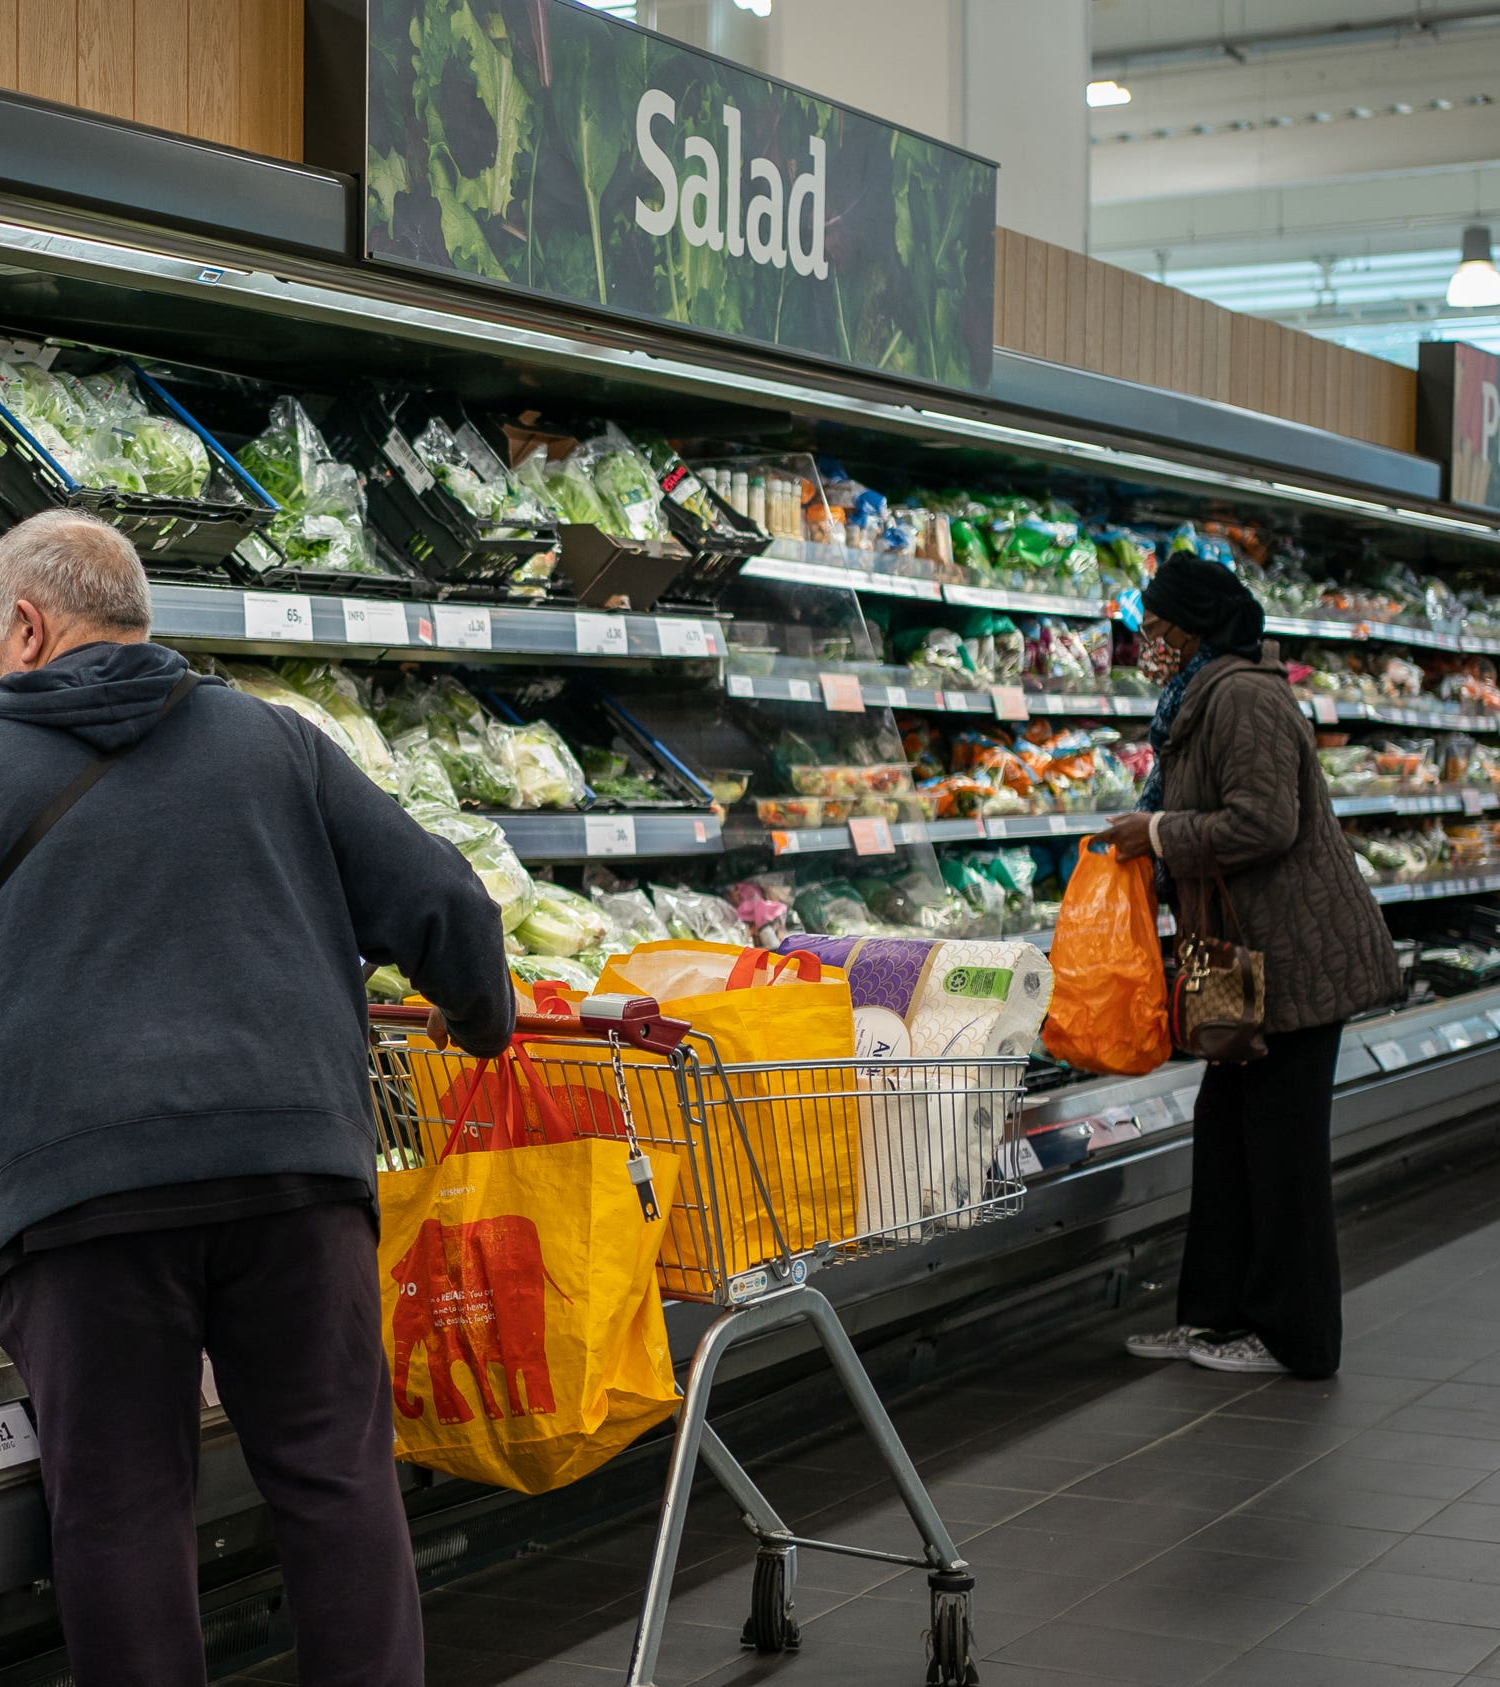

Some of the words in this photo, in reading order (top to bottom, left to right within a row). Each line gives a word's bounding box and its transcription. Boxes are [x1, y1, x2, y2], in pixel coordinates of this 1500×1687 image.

[635, 88, 829, 281] Salad
[1482, 380, 1500, 462] P
[286, 608, 303, 625] 65p
[347, 610, 365, 622] INFO
